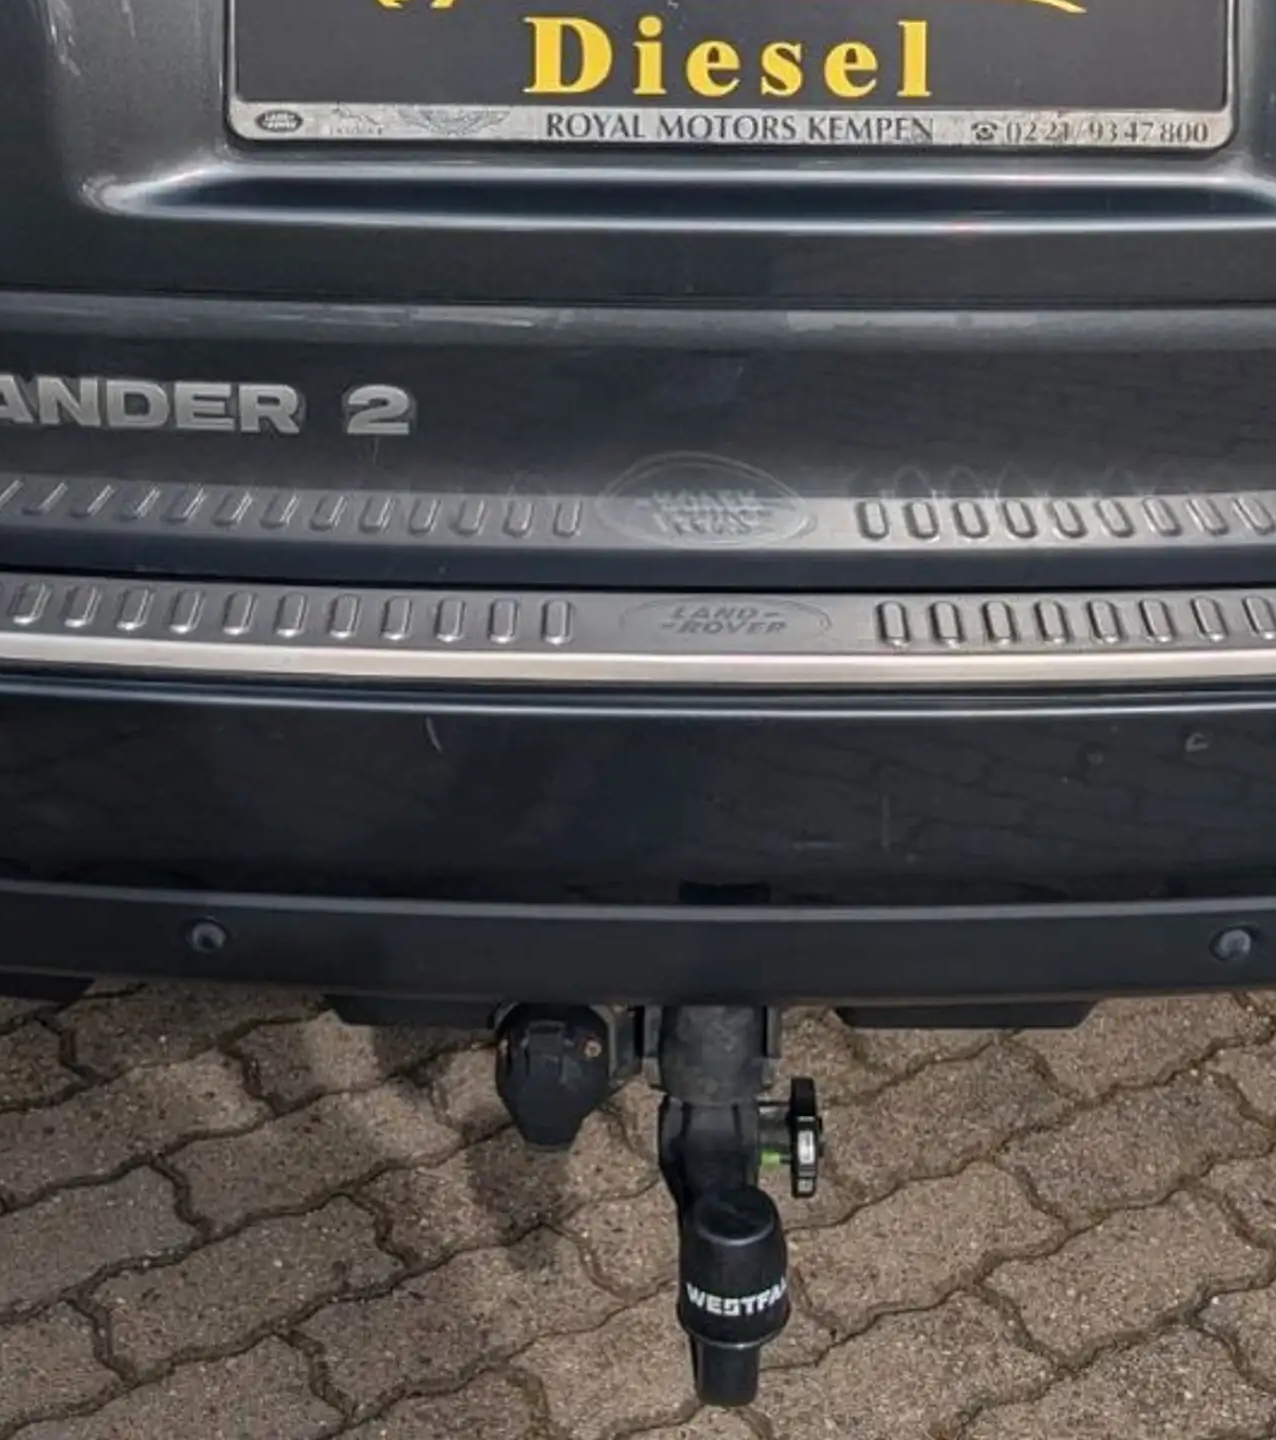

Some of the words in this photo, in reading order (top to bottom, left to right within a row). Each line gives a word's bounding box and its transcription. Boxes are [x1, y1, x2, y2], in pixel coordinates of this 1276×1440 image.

[523, 15, 932, 97] Diesel
[546, 112, 645, 139] ROYAL
[656, 114, 797, 140] MOTORS
[807, 115, 934, 141] KEMPEN
[346, 383, 411, 436] 2
